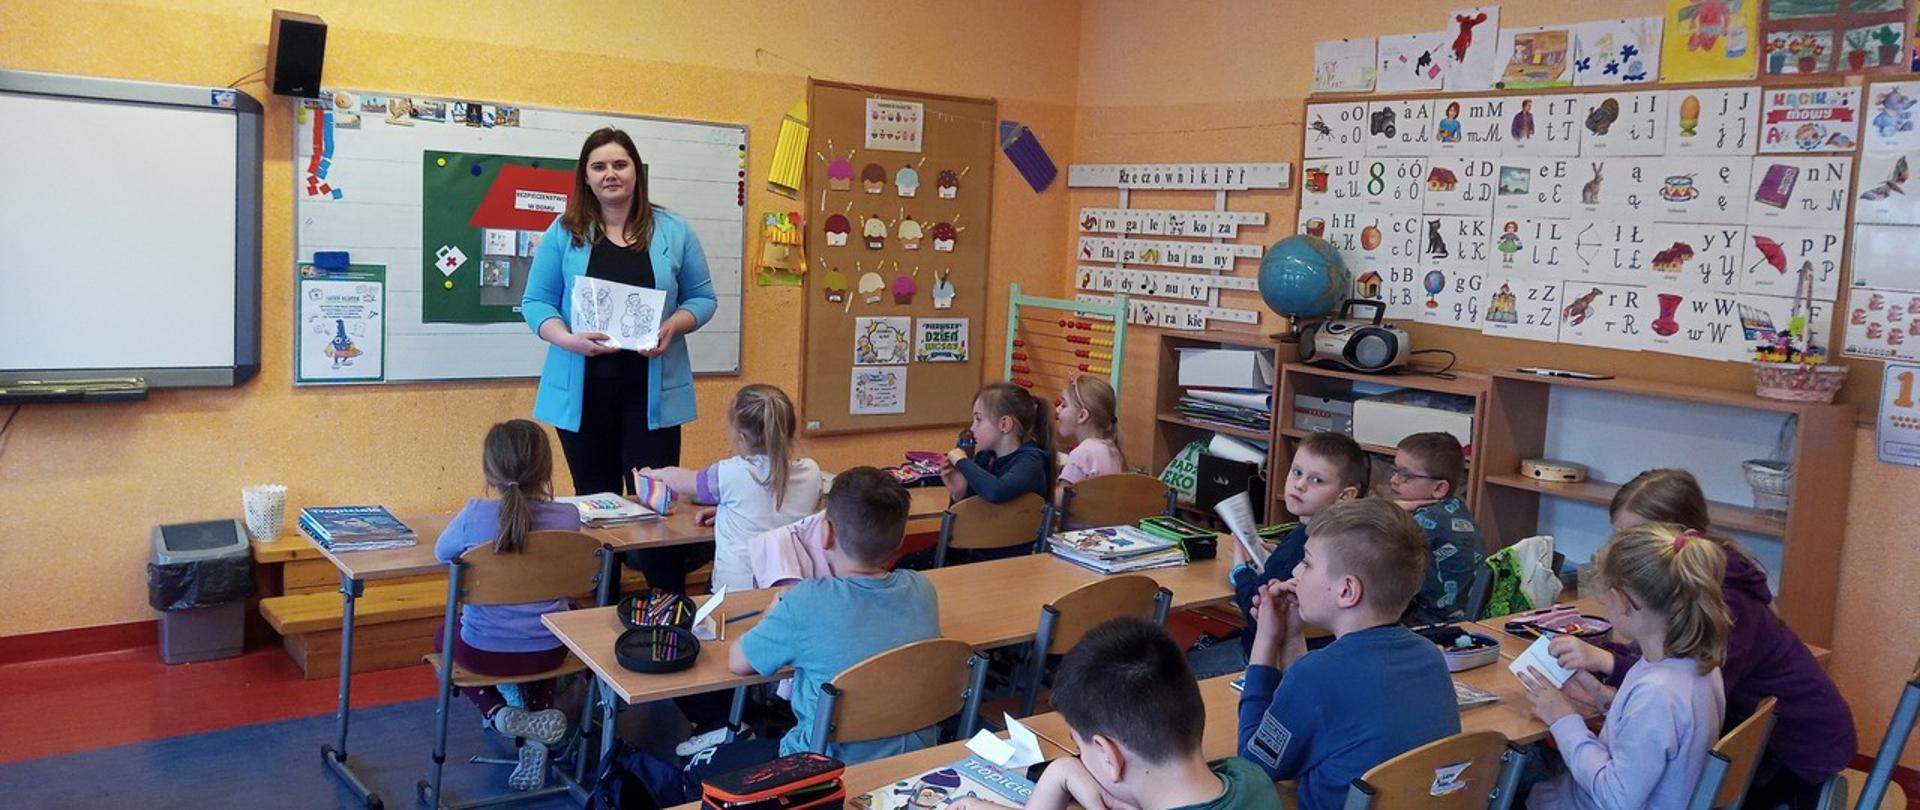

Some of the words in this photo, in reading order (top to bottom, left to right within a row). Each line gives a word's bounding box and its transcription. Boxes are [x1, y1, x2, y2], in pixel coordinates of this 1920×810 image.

[1367, 162, 1385, 195] 8
[1893, 371, 1914, 408] 1
[1162, 470, 1195, 490] EKO
[963, 758, 1033, 798] Tropicie
